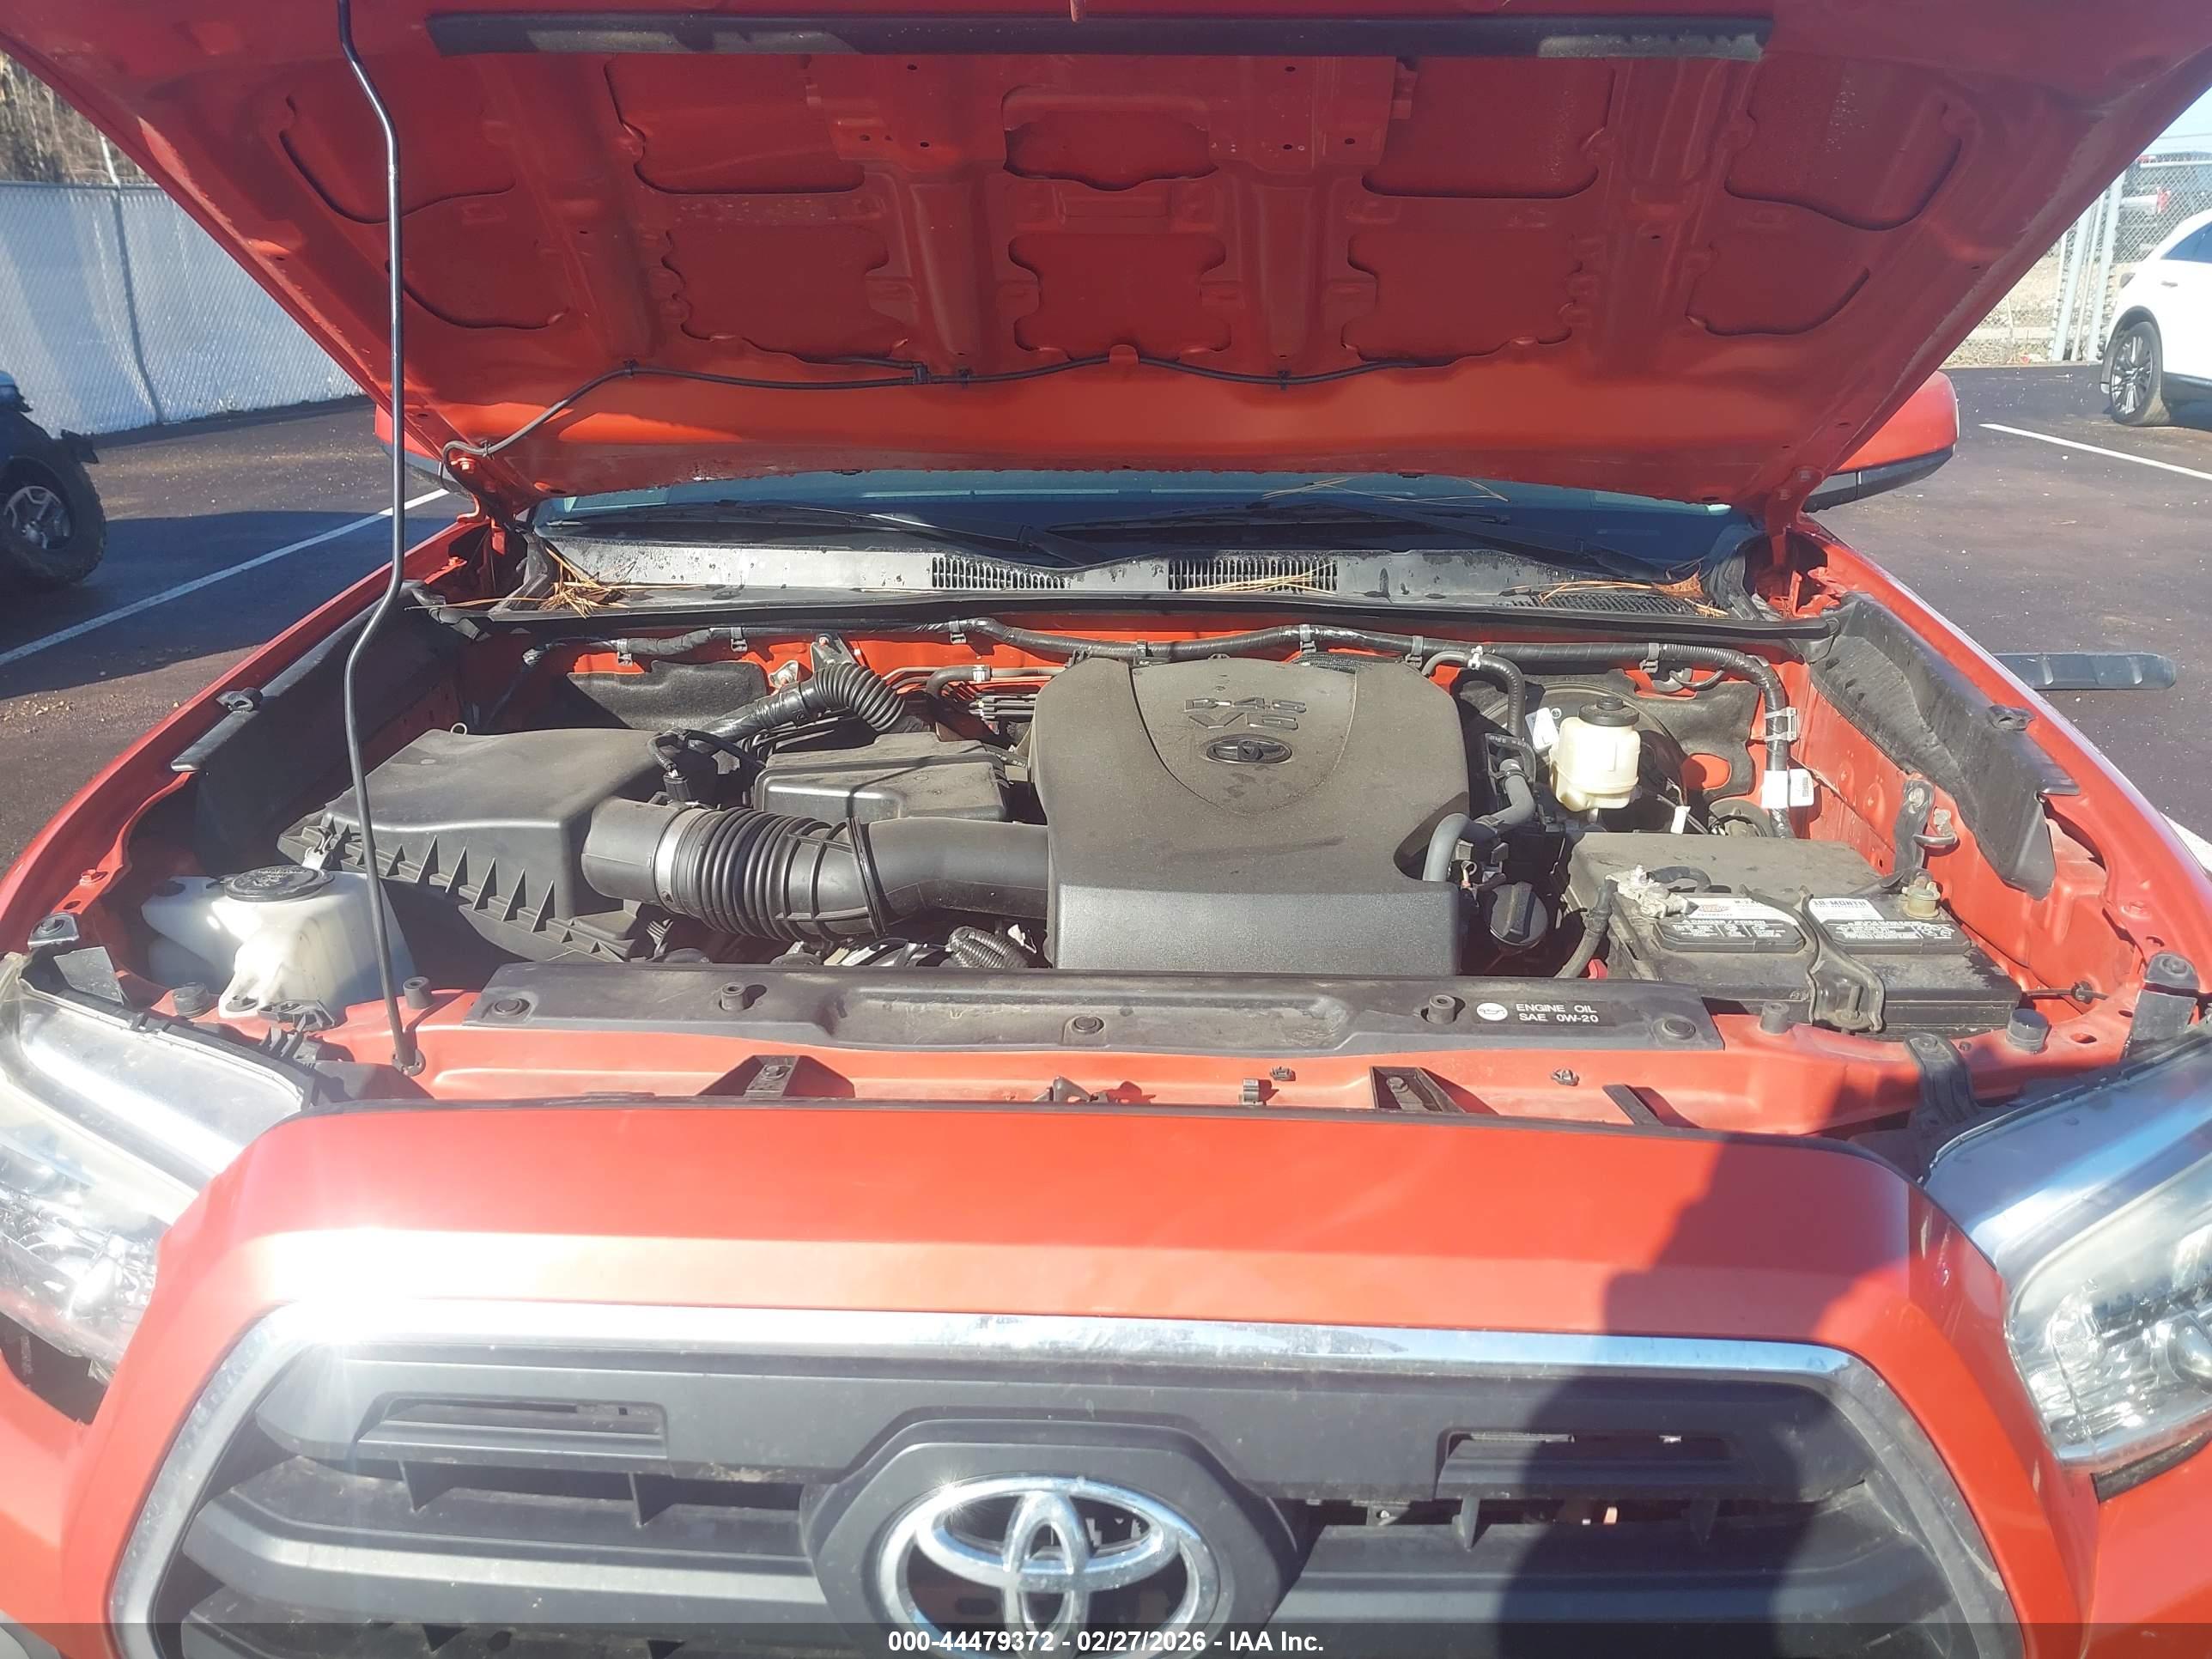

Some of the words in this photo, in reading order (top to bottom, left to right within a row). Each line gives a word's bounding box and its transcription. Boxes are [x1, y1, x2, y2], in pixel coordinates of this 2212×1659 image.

[1188, 712, 1298, 731] V6
[1516, 1004, 1565, 1012] ENGINE
[1573, 1005, 1597, 1013] OIL
[1519, 1013, 1548, 1022] SAE
[1556, 1014, 1599, 1023] 0W-20
